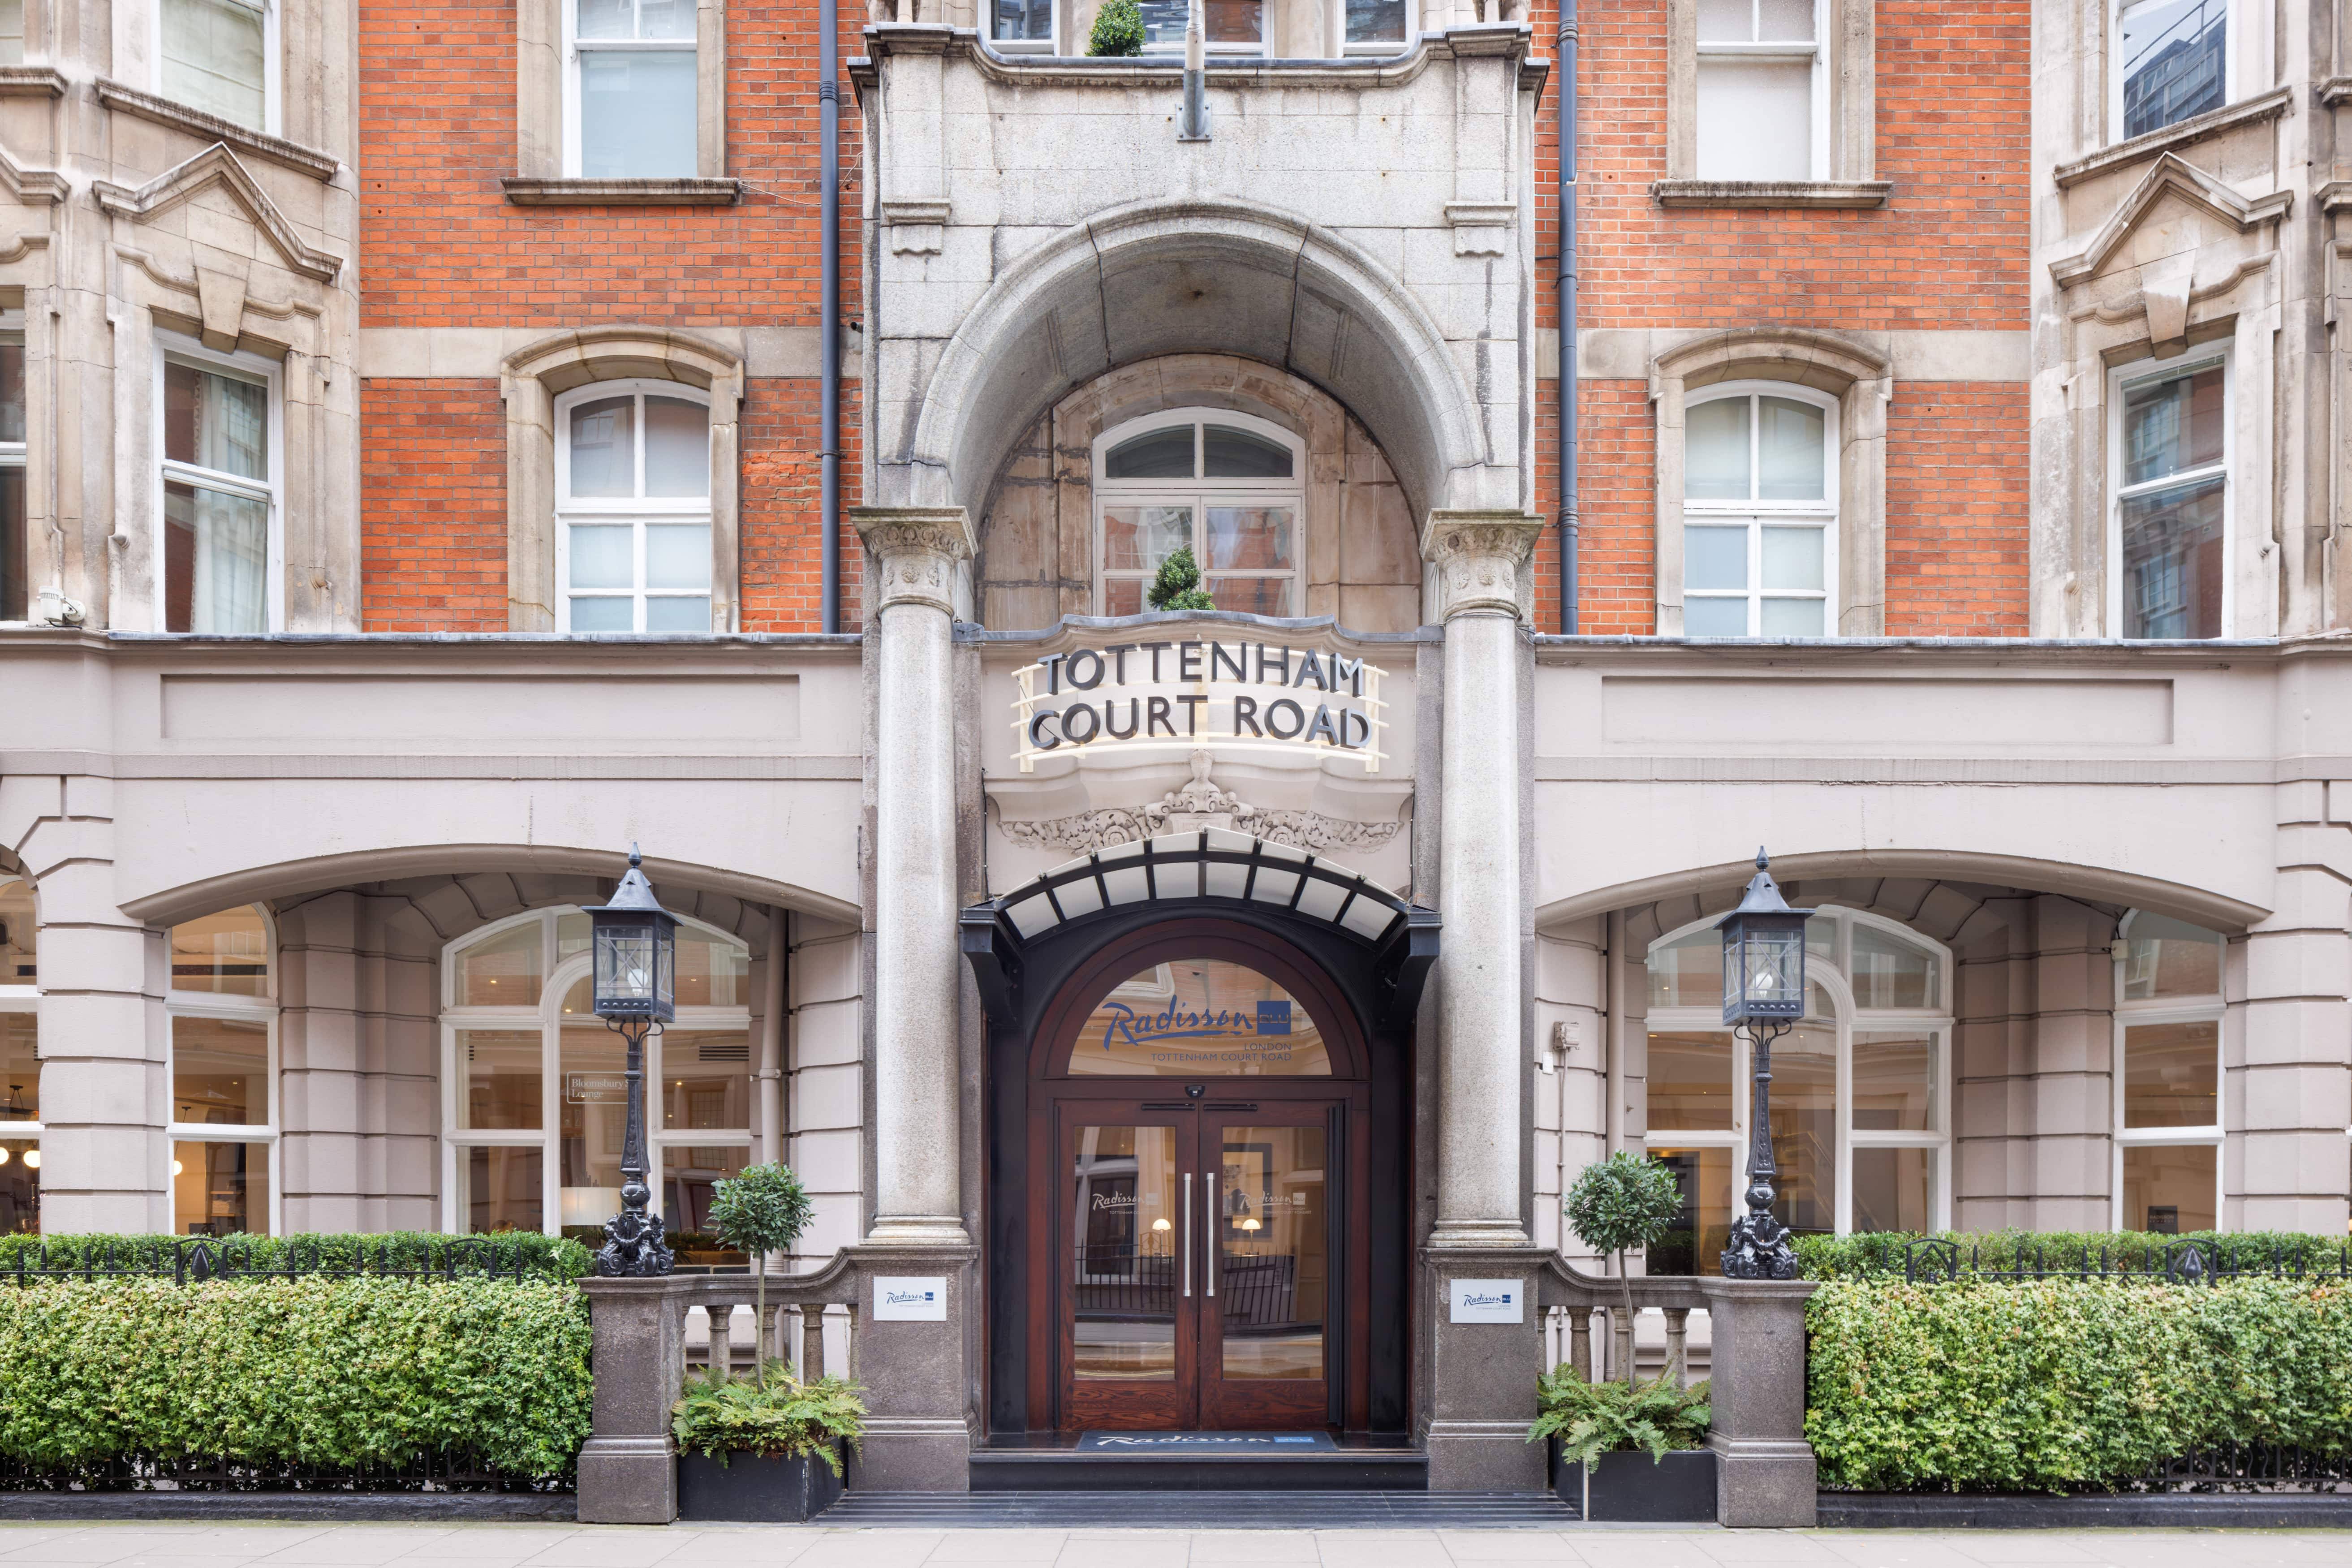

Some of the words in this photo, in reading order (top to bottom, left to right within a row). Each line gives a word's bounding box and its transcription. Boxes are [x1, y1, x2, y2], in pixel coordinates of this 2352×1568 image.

[1038, 641, 1363, 698] TOTTENHAM
[1029, 694, 1208, 750] COURT
[1234, 695, 1372, 750] ROAD
[1102, 994, 1254, 1051] Radisson
[1244, 1042, 1292, 1051] LONDON
[1151, 1053, 1217, 1061] TOTTENHAM
[1221, 1053, 1257, 1061] COURT
[1262, 1053, 1292, 1061] ROAD
[572, 1078, 624, 1089] Bloomsbury
[572, 1089, 603, 1099] Lounge
[1092, 1191, 1144, 1210] Radisson
[1240, 1190, 1292, 1210] Radisson
[887, 1291, 924, 1304] Radisson
[1464, 1293, 1501, 1306] Radisson
[1097, 1435, 1271, 1446] Radisson
